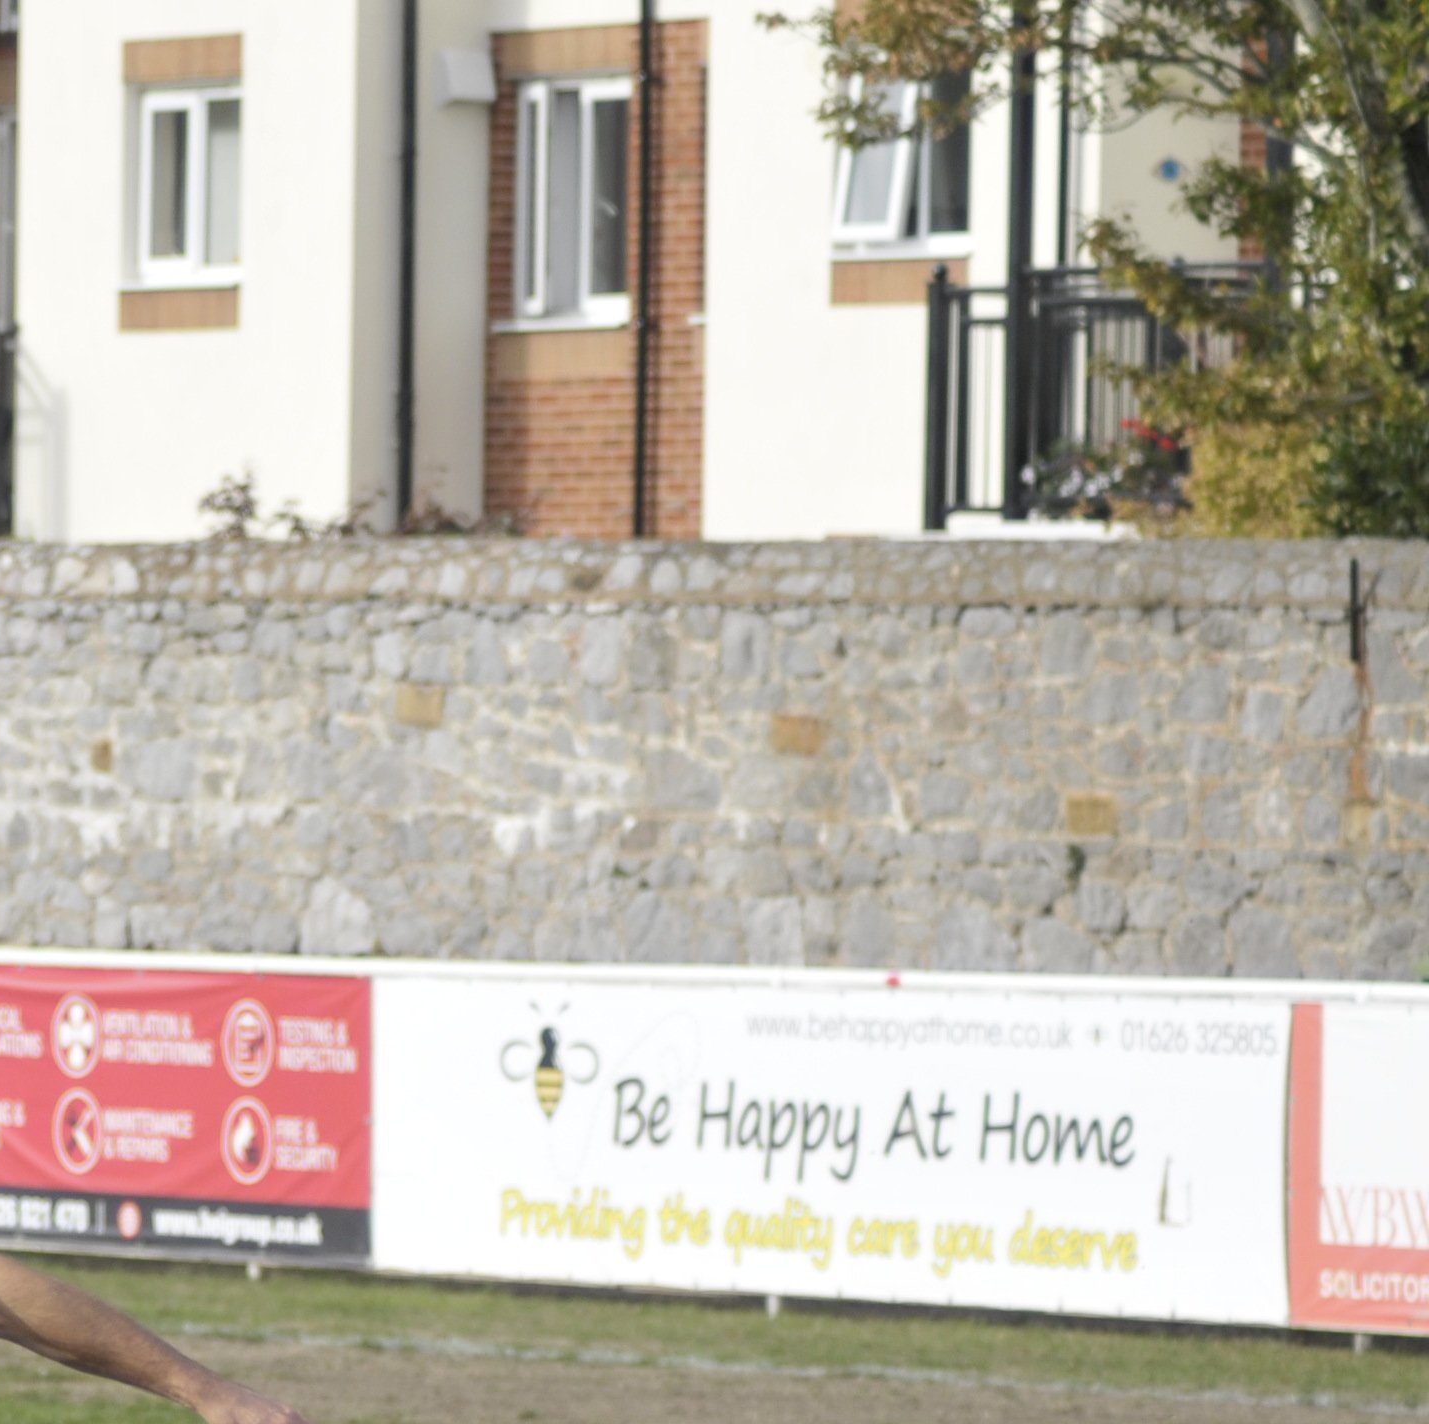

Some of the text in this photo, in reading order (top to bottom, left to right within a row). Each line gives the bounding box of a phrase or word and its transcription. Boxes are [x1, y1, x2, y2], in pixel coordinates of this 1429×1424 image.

[104, 1011, 179, 1039] VENTILATION
[278, 1017, 334, 1044] TESTING
[746, 1012, 1073, 1050] www.behappyathome.co.uk
[1120, 1020, 1188, 1053] 01626
[126, 1040, 214, 1067] CONDITIONING
[279, 1046, 357, 1073] INSPECTION
[105, 1110, 193, 1139] MAINTENANCE
[276, 1117, 302, 1142] FIRE
[613, 1078, 1135, 1183] Be Happy At Home
[276, 1145, 338, 1171] SECURITY
[500, 1186, 1139, 1276] Providing the quality care you deserve
